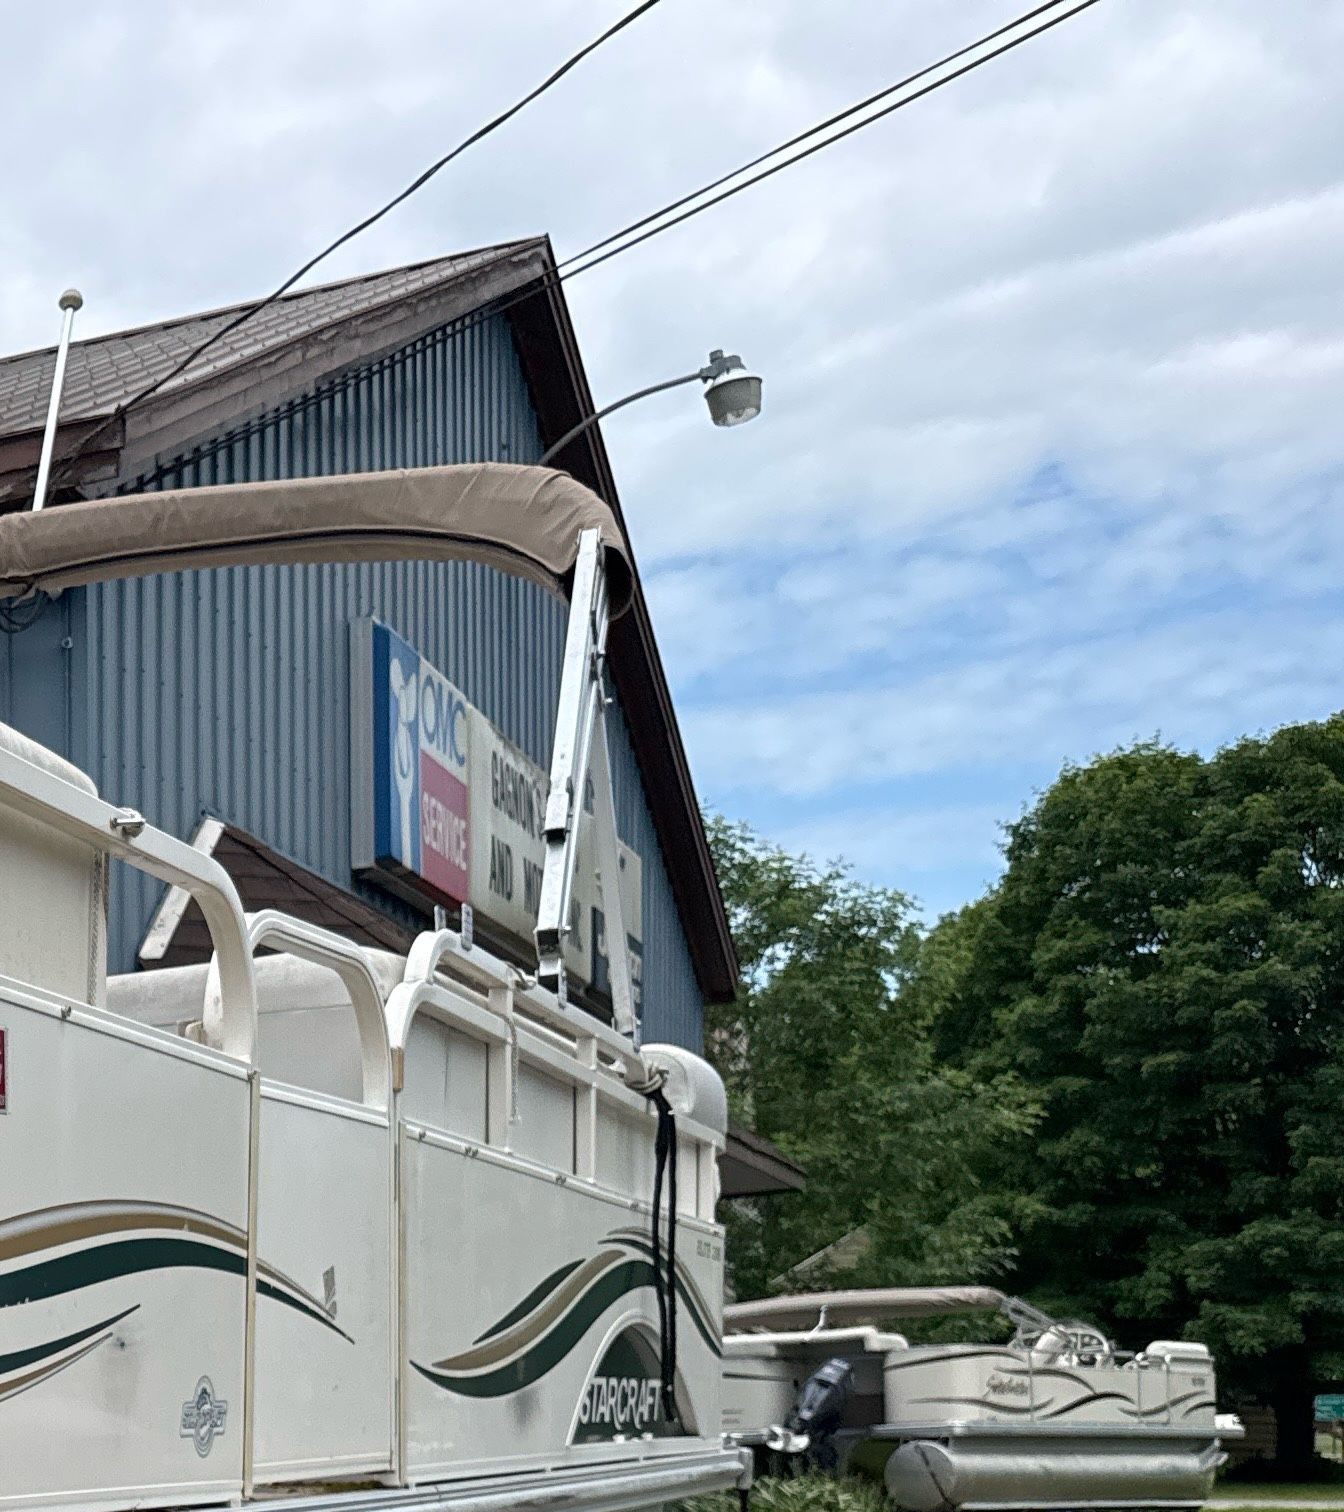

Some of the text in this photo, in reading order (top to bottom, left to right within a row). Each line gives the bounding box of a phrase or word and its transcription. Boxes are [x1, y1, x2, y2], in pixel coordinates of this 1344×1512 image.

[421, 674, 466, 768] OMC
[422, 790, 468, 872] SERVICE
[489, 834, 514, 902] AND
[578, 1376, 663, 1431] STARCRAFT
